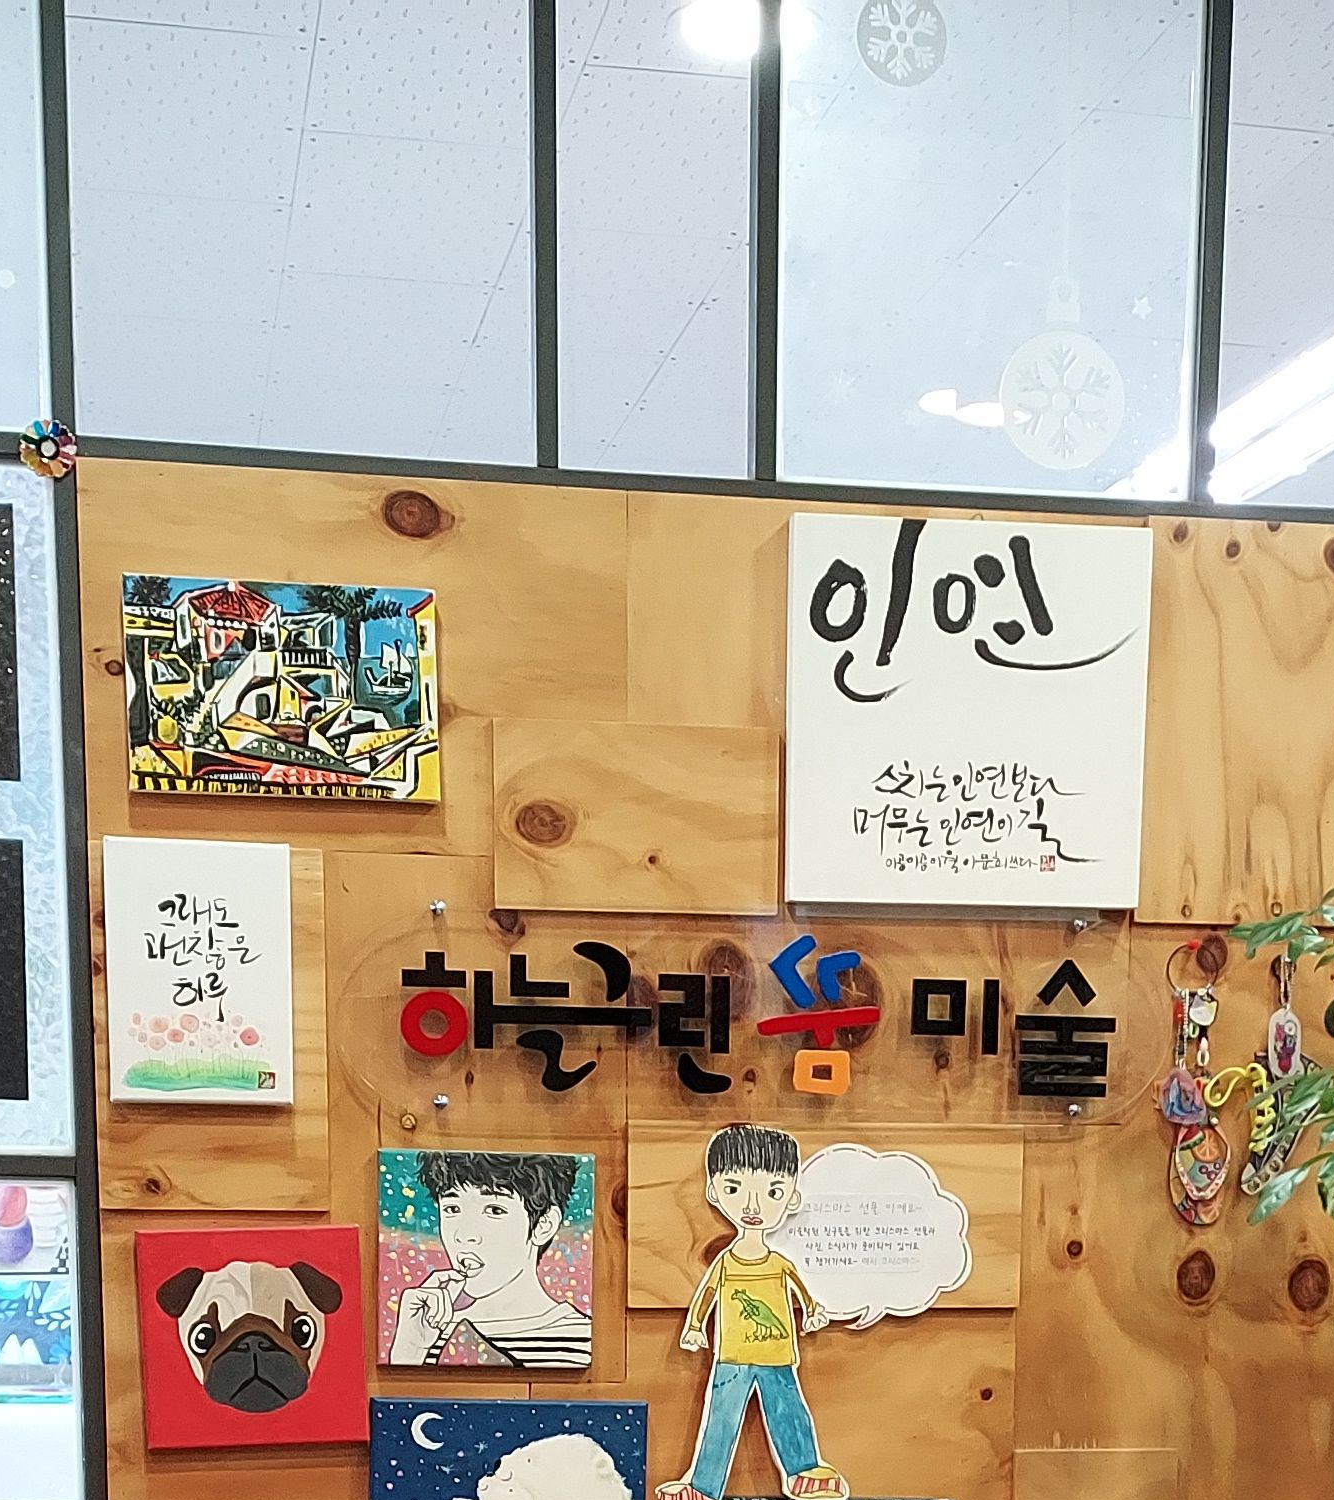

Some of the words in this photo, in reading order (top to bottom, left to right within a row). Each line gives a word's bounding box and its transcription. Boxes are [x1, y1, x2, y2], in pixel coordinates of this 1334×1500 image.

[809, 518, 1138, 703] 인연
[157, 893, 239, 928] 그래도
[143, 927, 264, 970] 괜찮은
[171, 971, 228, 1023] 하루
